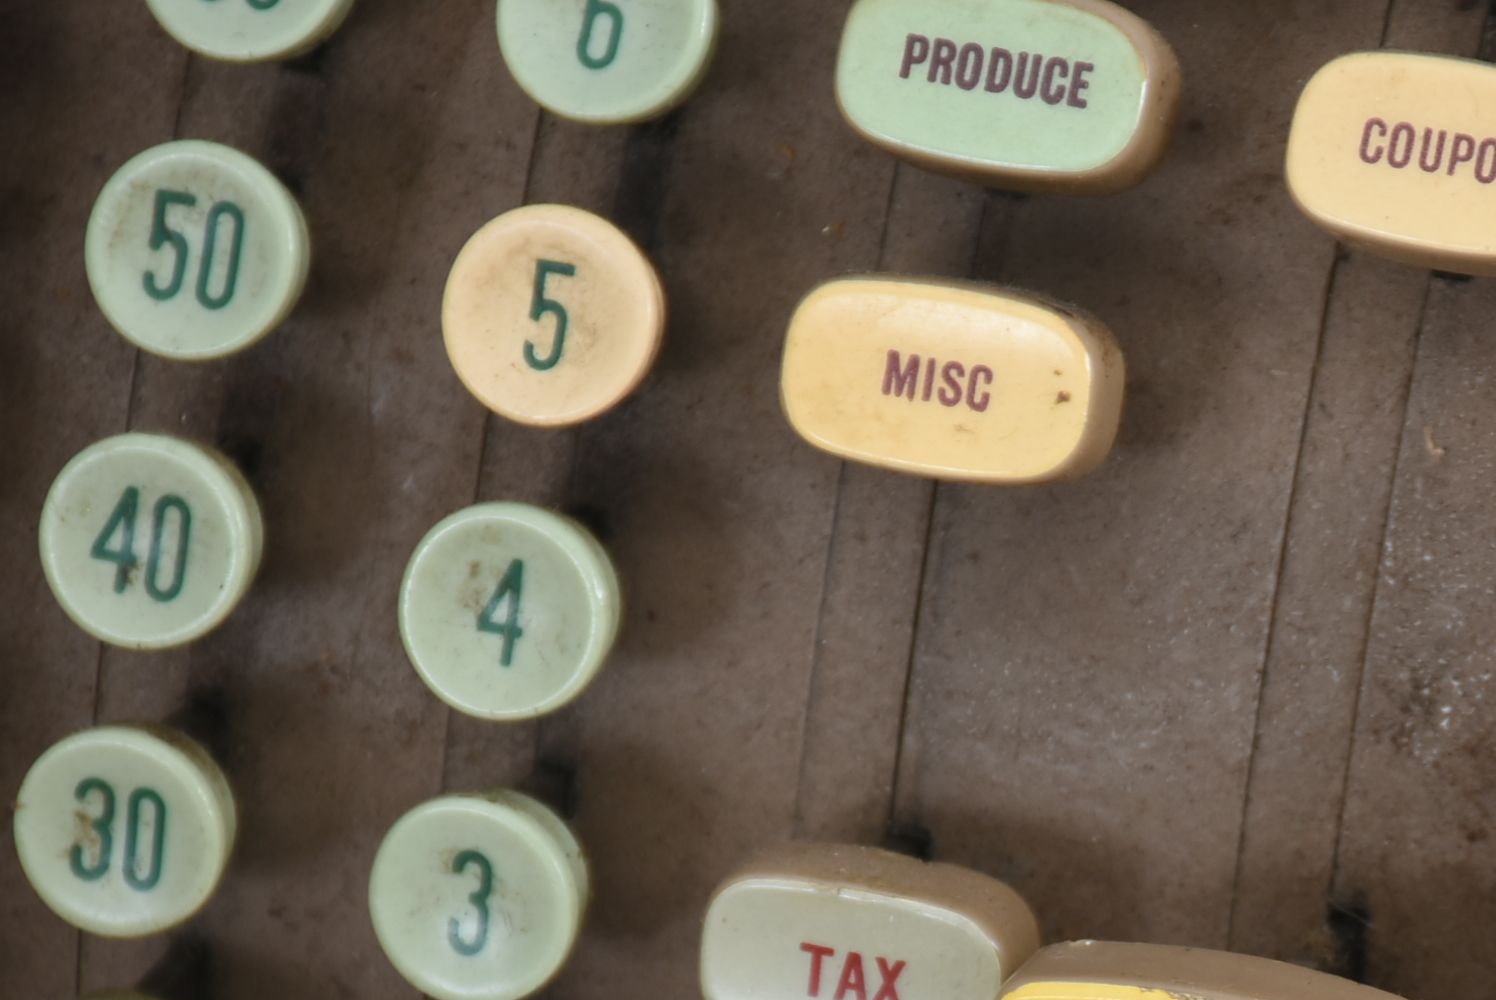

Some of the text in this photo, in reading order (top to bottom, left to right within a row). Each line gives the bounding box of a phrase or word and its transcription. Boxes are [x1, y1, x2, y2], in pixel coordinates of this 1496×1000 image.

[575, 0, 624, 70] 6
[899, 33, 1095, 110] PRODUCE
[142, 189, 245, 310] 50
[522, 259, 577, 371] 5
[881, 349, 994, 413] MISC
[90, 485, 192, 602] 40
[475, 558, 524, 667] 4
[70, 777, 167, 892] 30
[447, 850, 495, 956] 3
